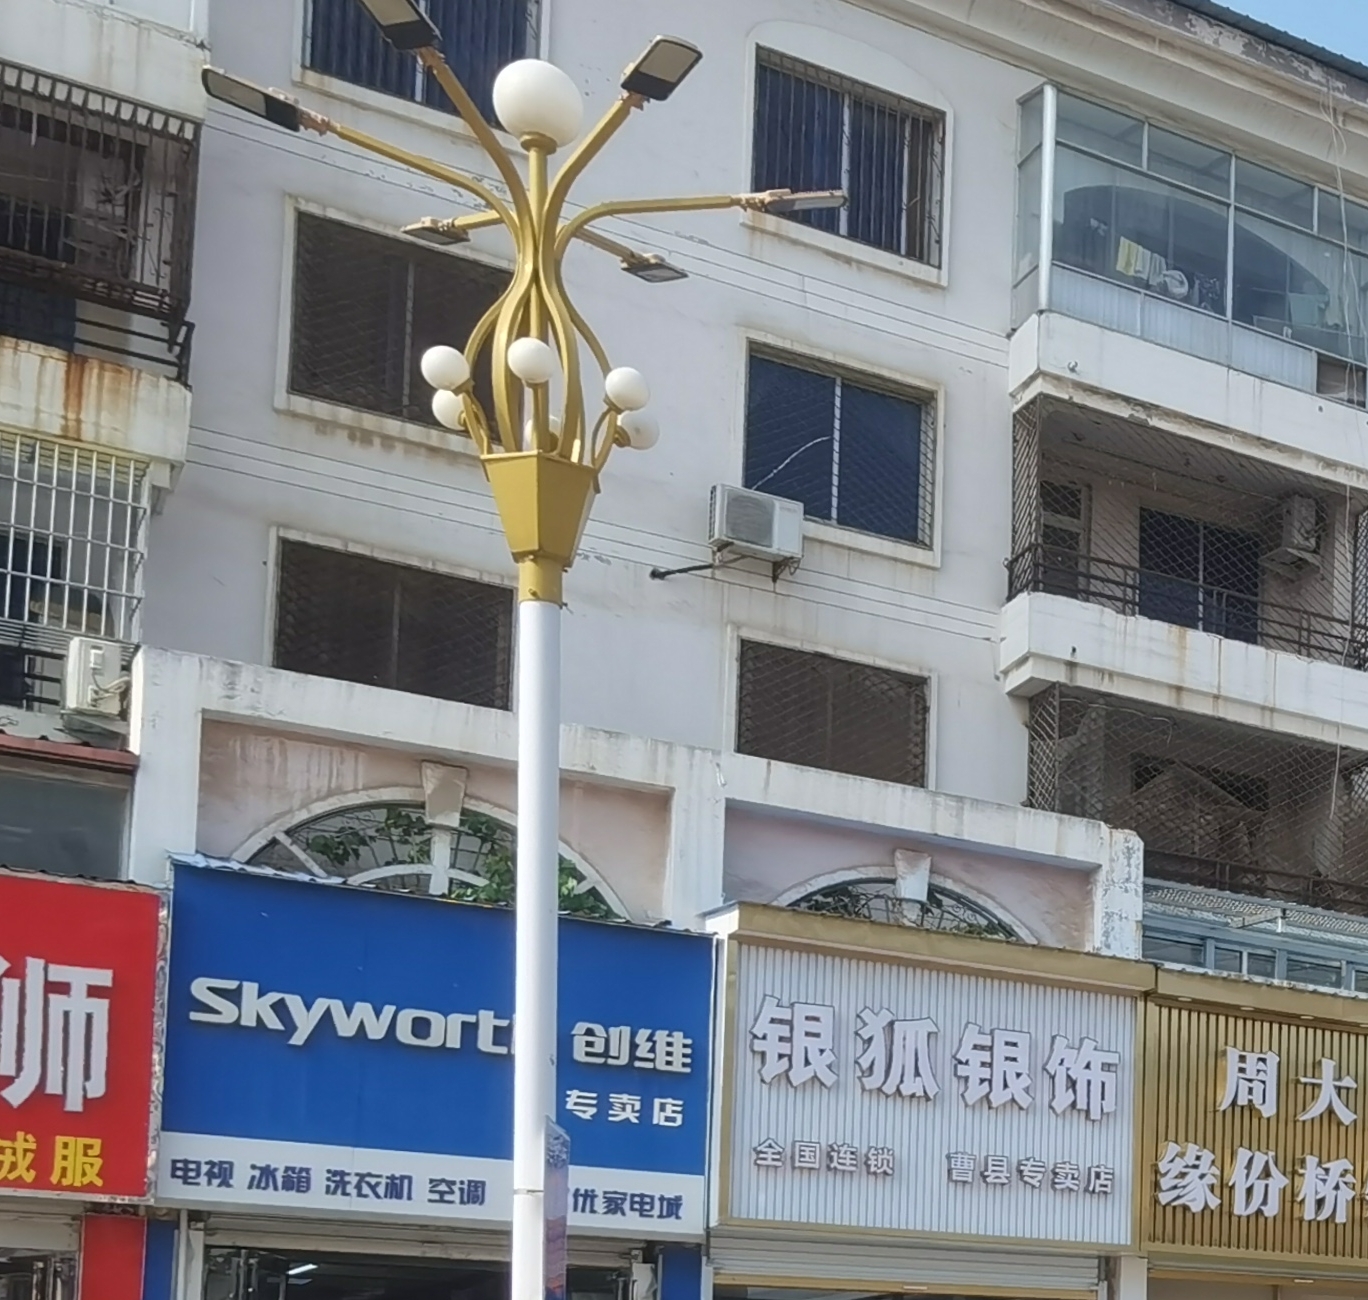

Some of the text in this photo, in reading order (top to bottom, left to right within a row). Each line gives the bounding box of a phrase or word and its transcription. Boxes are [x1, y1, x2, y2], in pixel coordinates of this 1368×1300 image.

[189, 977, 514, 1055] Skywort
[571, 1020, 694, 1074] 创维
[749, 994, 1121, 1121] 银狐银饰
[565, 1089, 685, 1126] 专卖店
[170, 1158, 684, 1221] 电视 冰箱 洗衣机 空调 优家电城
[753, 1138, 1115, 1194] 全国连锁 曹县专卖店
